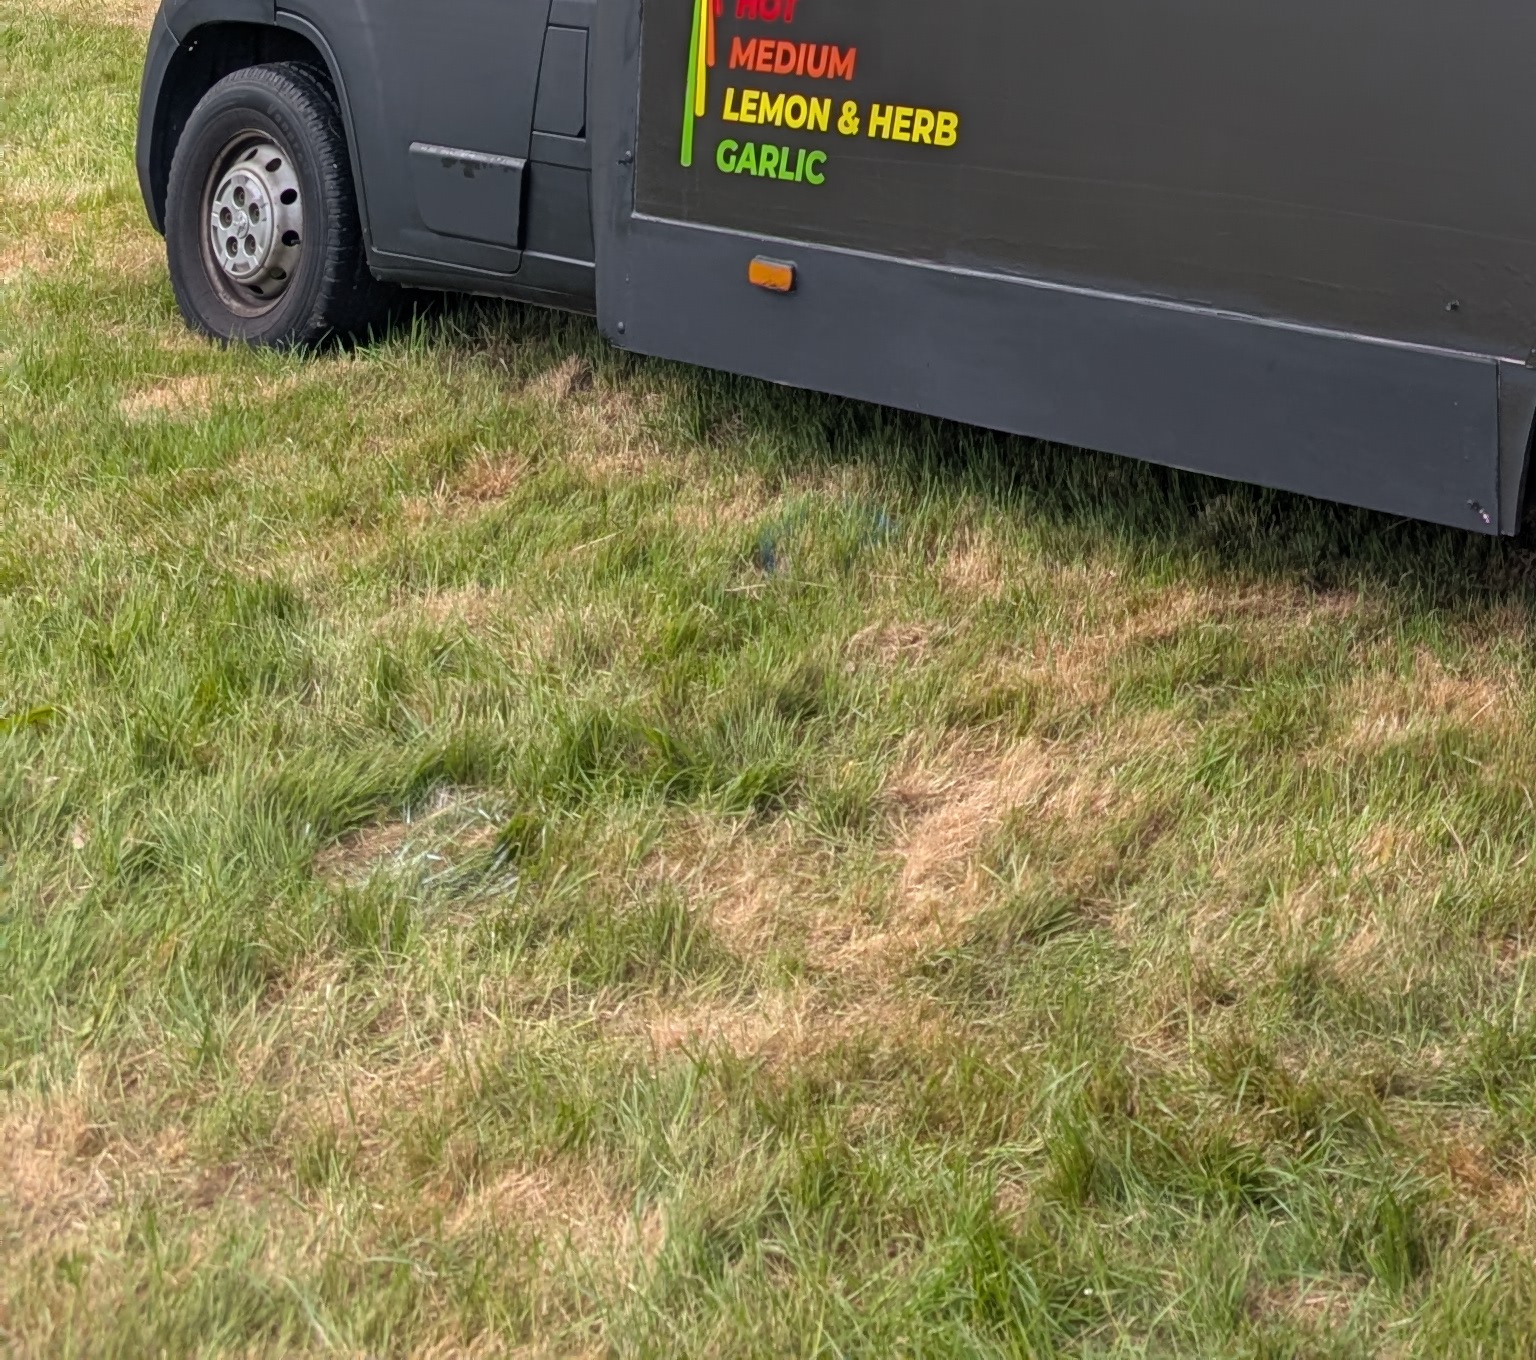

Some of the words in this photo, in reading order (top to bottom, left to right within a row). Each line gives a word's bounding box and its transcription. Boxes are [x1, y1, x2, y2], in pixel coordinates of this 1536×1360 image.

[729, 36, 857, 81] MEDIUM
[722, 87, 831, 132] LEMON
[837, 100, 860, 136] &
[867, 103, 959, 147] HERB
[716, 138, 828, 185] GARLIC
